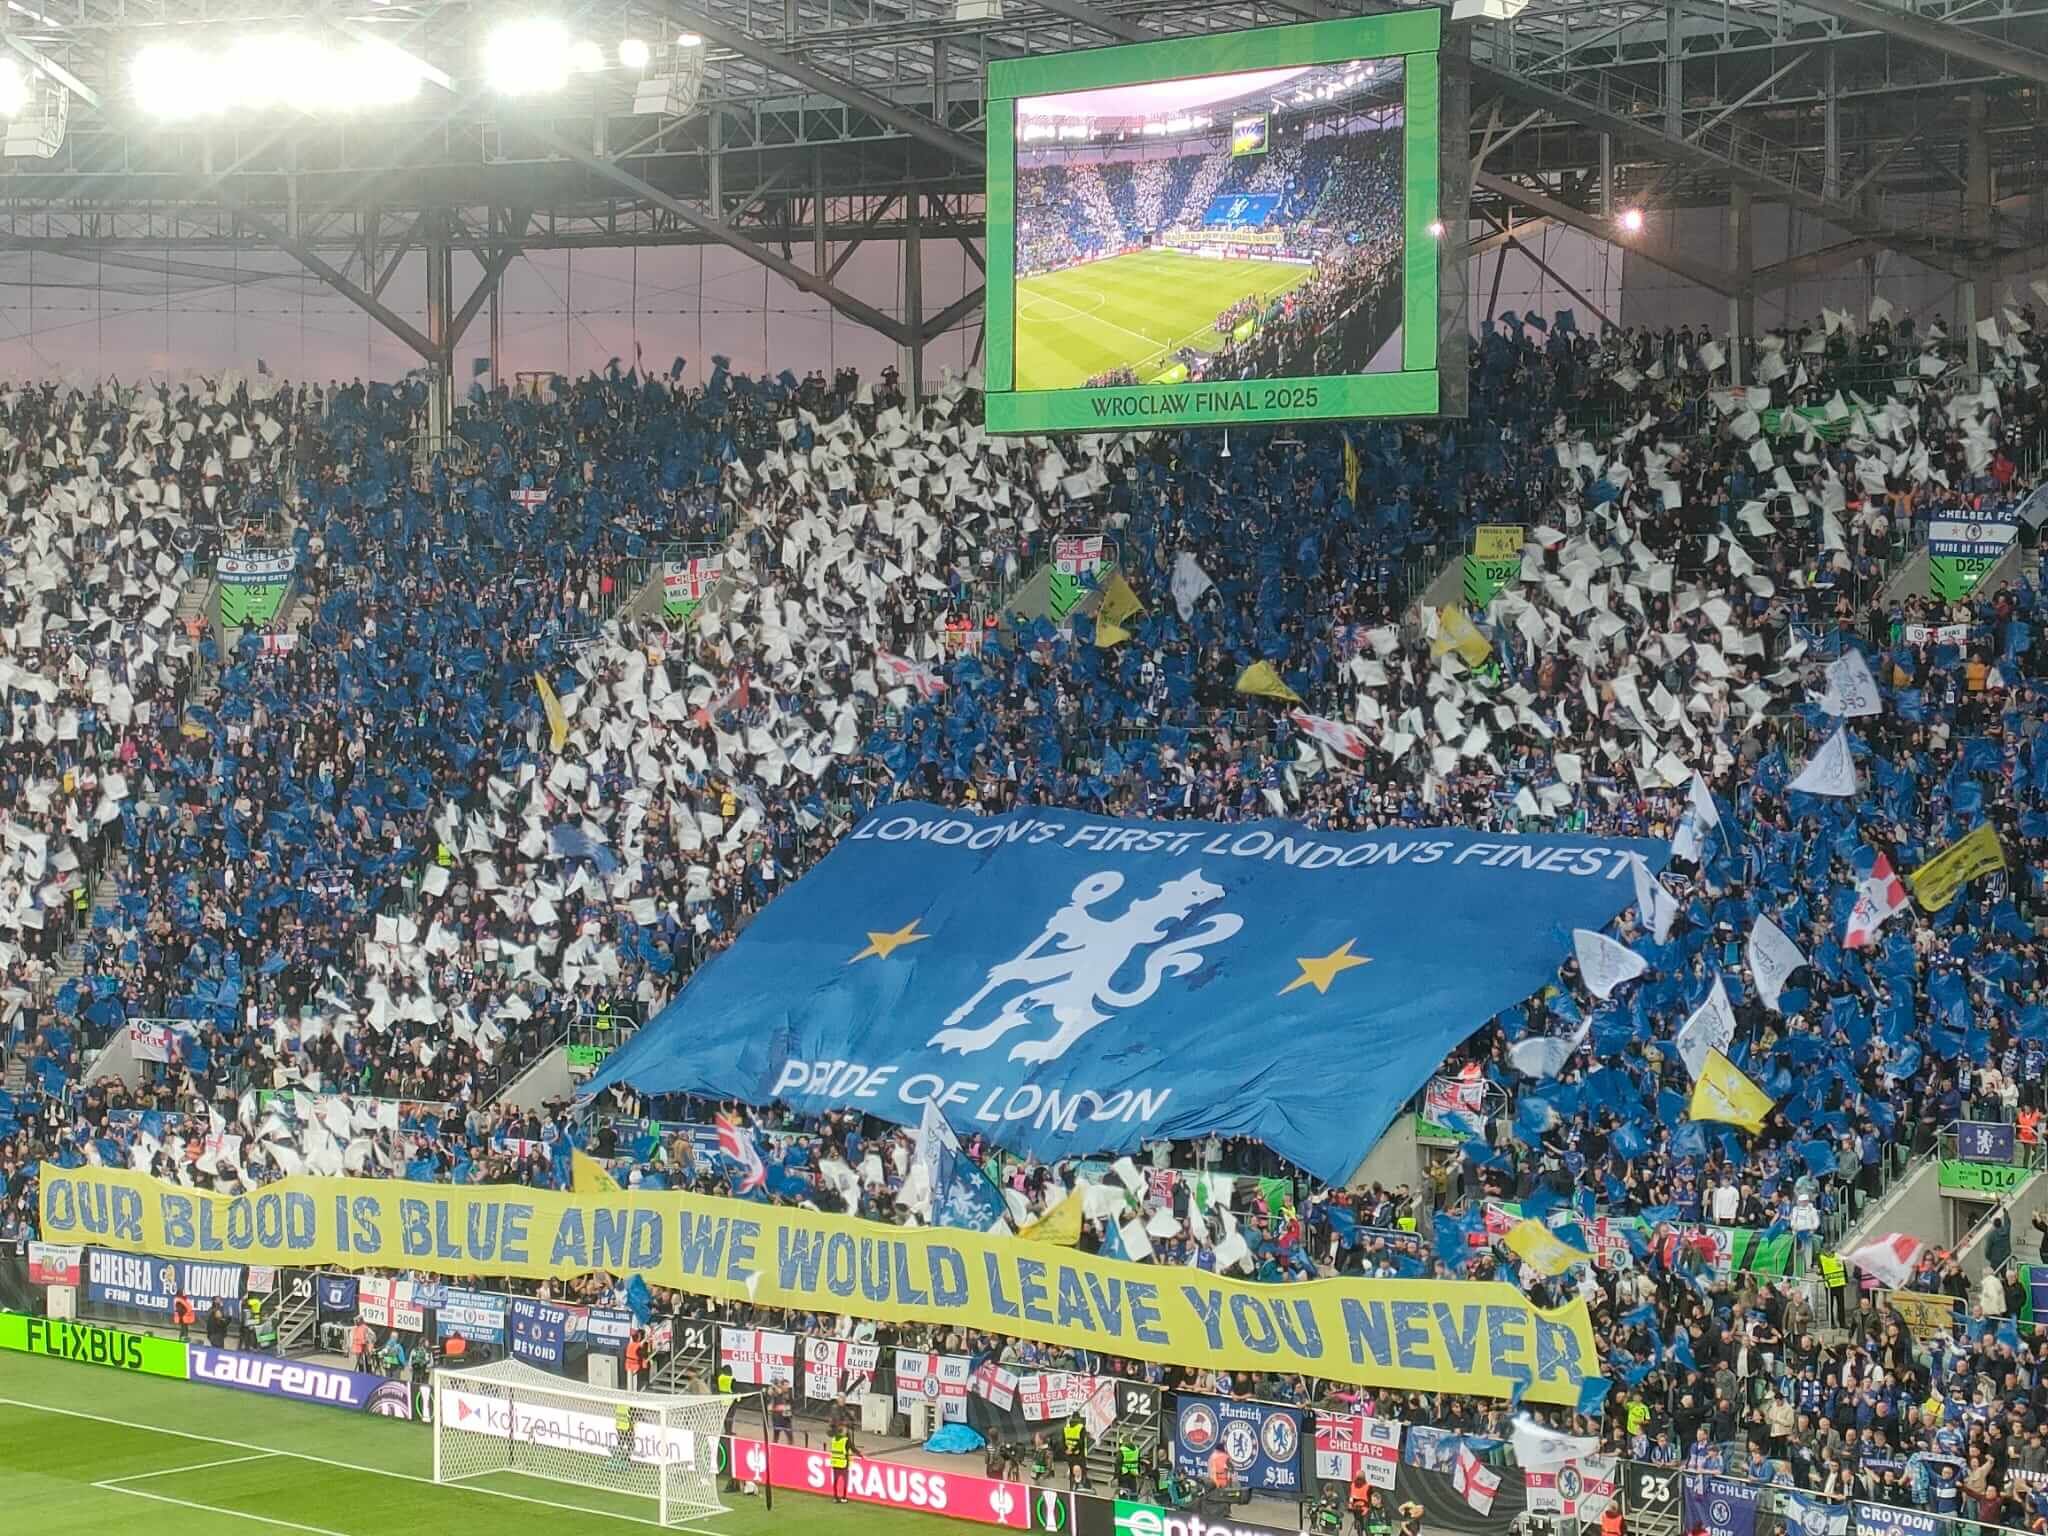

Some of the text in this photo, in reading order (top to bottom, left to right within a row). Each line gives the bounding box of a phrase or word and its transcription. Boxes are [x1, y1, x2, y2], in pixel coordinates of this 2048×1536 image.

[1196, 391, 1258, 412] FINAL
[1264, 387, 1318, 409] 2025
[1939, 509, 2012, 521] CHELSEA FC
[1935, 543, 1958, 553] PRIDE
[1486, 567, 1511, 580] D24
[1956, 559, 1985, 572] D25
[674, 571, 713, 585] CHELSEA
[244, 585, 268, 596] X21
[851, 816, 1648, 880] LONDON'S FIRST, LONDON'S FINEST
[770, 1060, 1173, 1132] PRIDE OF LONDON
[45, 1179, 1586, 1386] OUR BLOOD IS BLUE AND WE WOULD LEAVE YOU NEVER
[90, 1252, 241, 1299] CHELSEA LONDON
[104, 1287, 131, 1302] FAN
[135, 1293, 169, 1309] CLUB
[292, 1277, 313, 1298] 20
[362, 1307, 421, 1328] 1971 2008
[514, 1302, 564, 1324] ONE STEP
[684, 1327, 706, 1349] 21
[1913, 1327, 1930, 1337] CFC
[513, 1339, 556, 1361] BEYOND
[732, 1350, 784, 1366] CHELSEA
[851, 1346, 874, 1357] SW17
[847, 1358, 874, 1369] BLUES
[902, 1359, 961, 1377] ANDY KRIS
[814, 1375, 829, 1384] CFC
[812, 1390, 831, 1400] TOUR
[1023, 1389, 1065, 1403] CHELSEA
[1126, 1391, 1152, 1415] 22
[1219, 1401, 1262, 1424] Harwich
[487, 1403, 681, 1461] kaizen founation
[1329, 1438, 1384, 1457] CHELSEA FC
[1531, 1473, 1542, 1486] 19
[1641, 1475, 1670, 1502] 23
[1685, 1476, 1759, 1500] BTCHLEY
[1861, 1506, 1935, 1531] CROYDON
